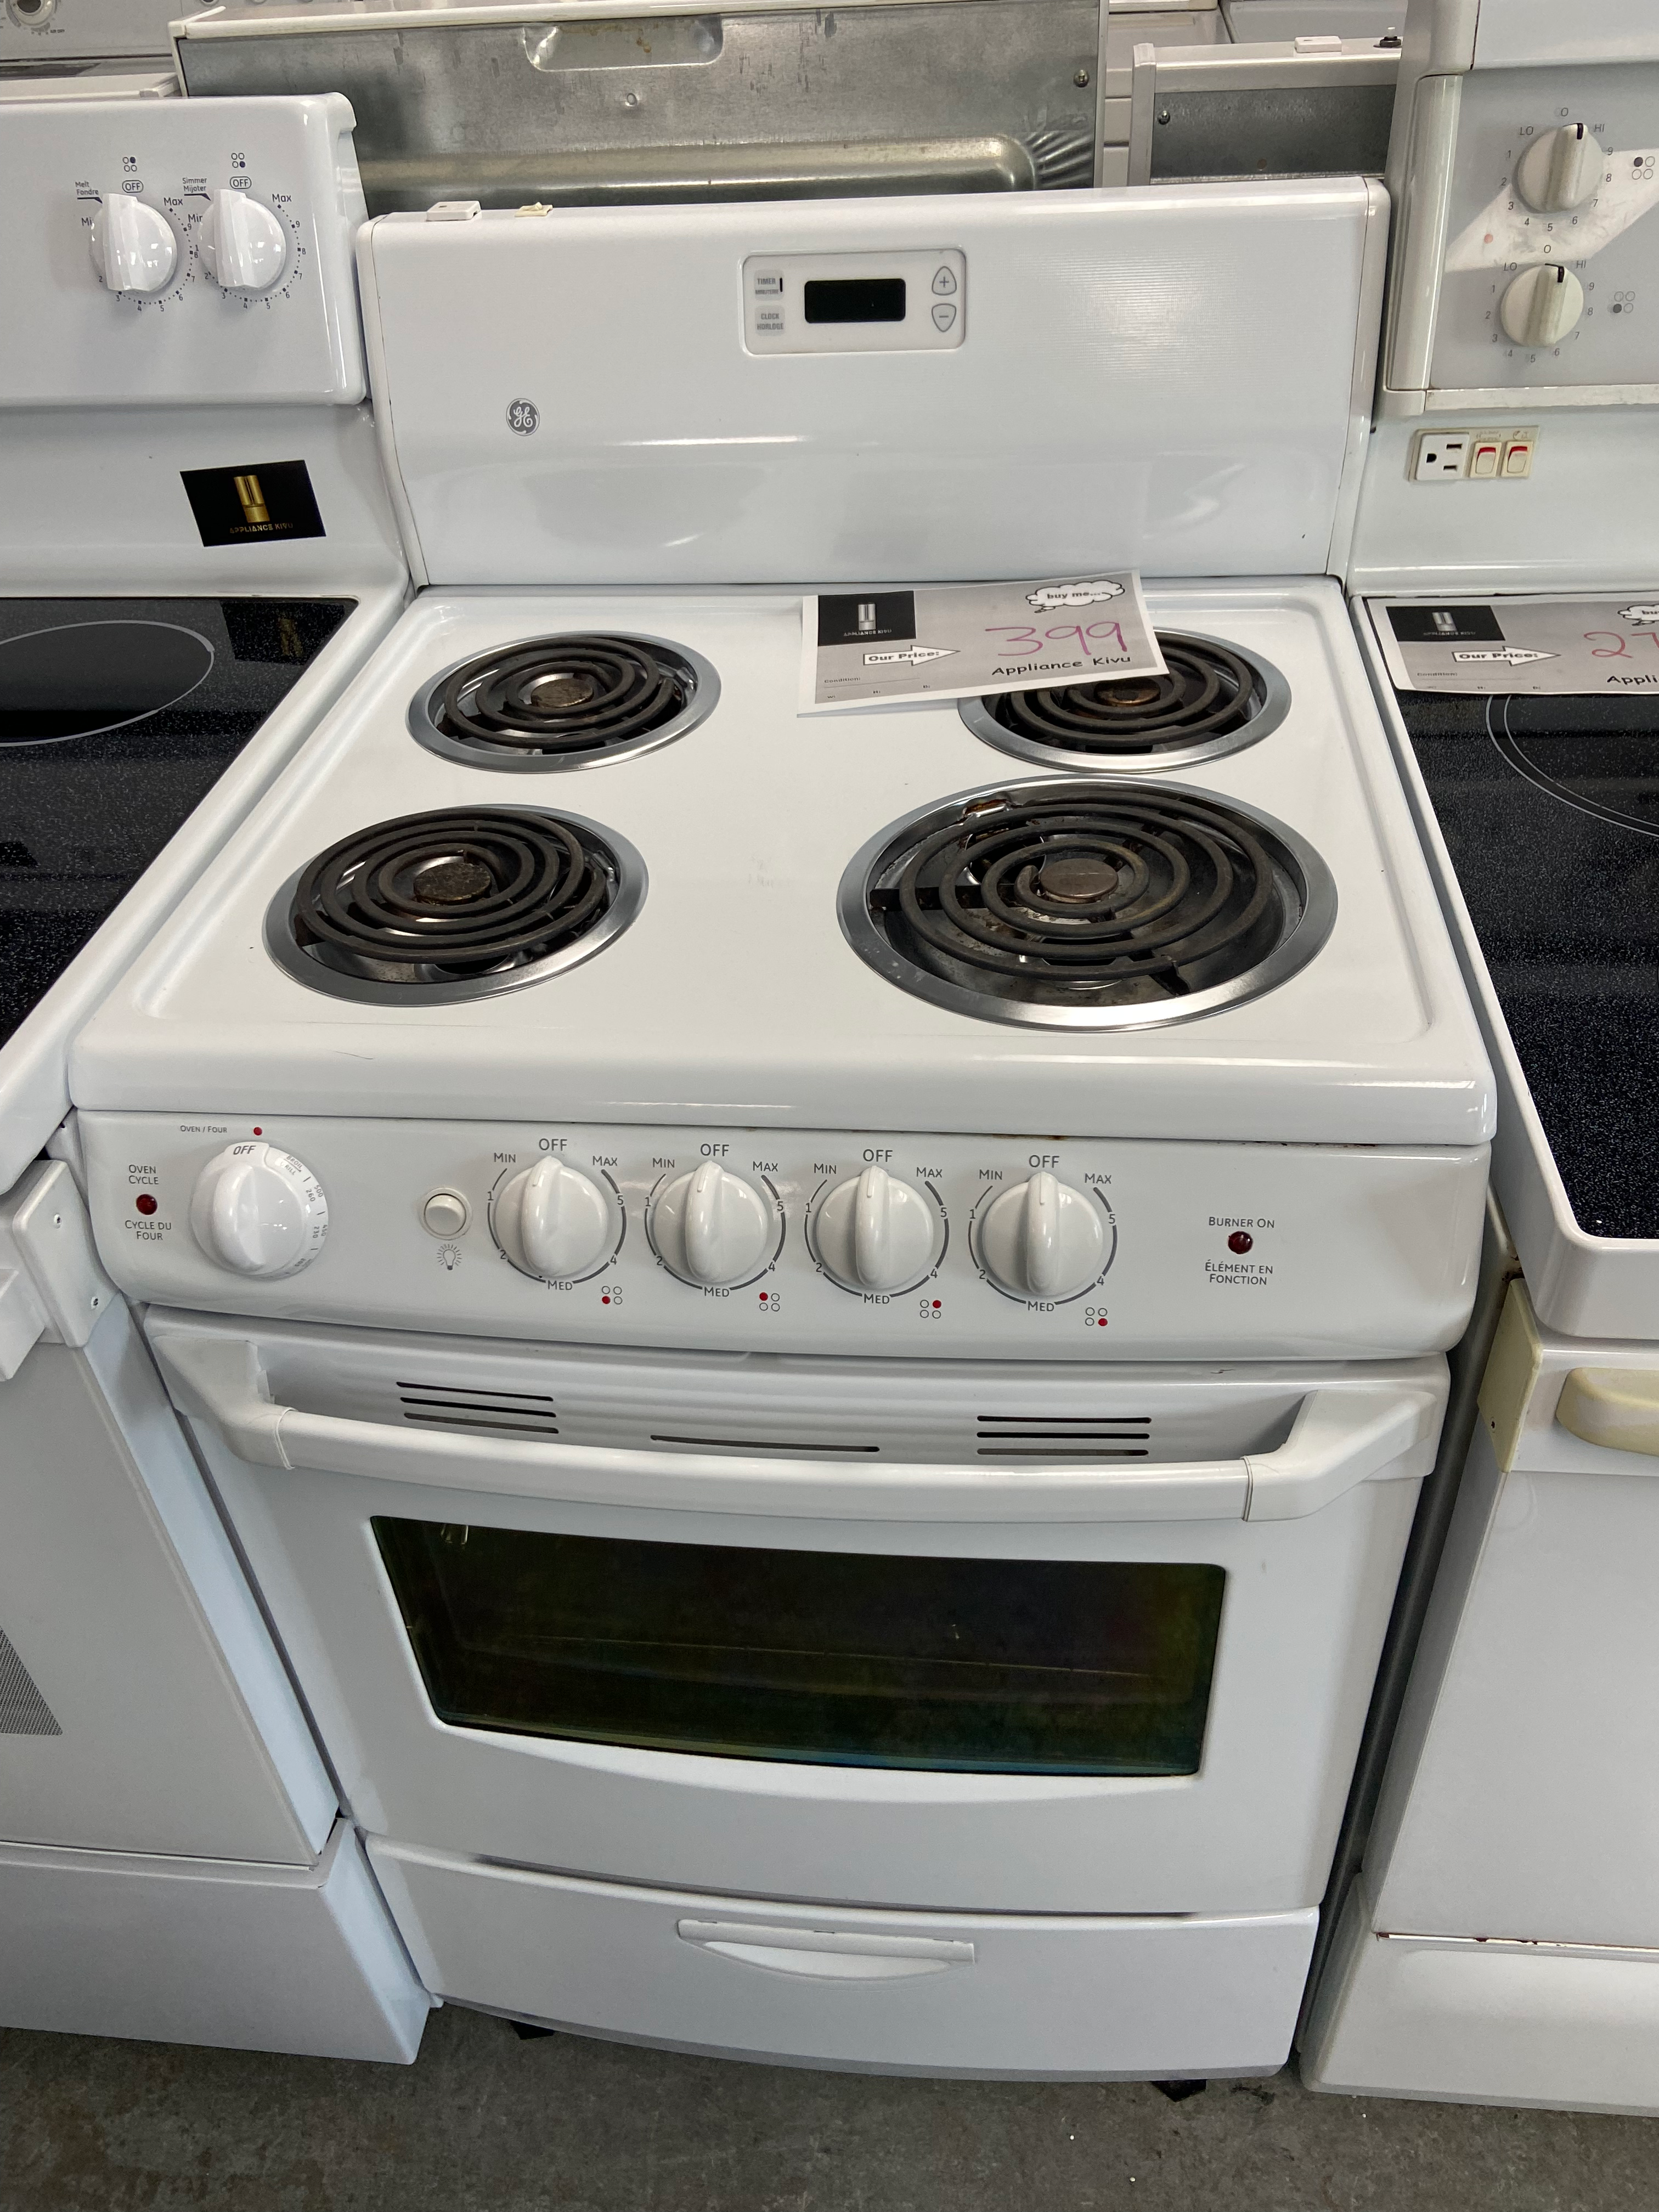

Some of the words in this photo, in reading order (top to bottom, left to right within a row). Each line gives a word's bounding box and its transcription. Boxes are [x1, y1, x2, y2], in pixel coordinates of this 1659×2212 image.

[1520, 127, 1533, 136] LO
[1595, 124, 1605, 132] HI
[1607, 146, 1613, 156] 9
[1501, 178, 1507, 186] 2
[1606, 174, 1611, 182] 8
[125, 183, 141, 191] OFF
[233, 179, 249, 187] OFF
[164, 198, 183, 206] Max
[272, 194, 292, 203] Max
[1508, 202, 1514, 210] 3
[1593, 199, 1599, 208] 7
[81, 217, 92, 226] Mi
[1525, 218, 1530, 226] 4
[1572, 217, 1578, 225] 6
[1548, 223, 1553, 232] 5
[1503, 262, 1517, 272] LO
[1576, 260, 1586, 269] HI
[1492, 285, 1496, 293] 1
[1589, 282, 1595, 291] 9
[1486, 311, 1491, 319] 2
[1587, 307, 1593, 316] 8
[1492, 334, 1498, 342] 3
[1575, 332, 1580, 341] 7
[1508, 349, 1513, 358] 4
[1554, 348, 1560, 357] 6
[1531, 354, 1536, 363] 5
[230, 524, 273, 533] APPLIANCE
[985, 621, 1127, 656] 399
[992, 661, 1083, 675] Appliance
[1093, 657, 1131, 665] Kivu
[1607, 675, 1659, 685] Appli
[539, 1138, 567, 1151] OFF
[233, 1146, 256, 1154] OFF
[700, 1144, 729, 1156] OFF
[494, 1153, 516, 1163] MIN
[863, 1149, 893, 1162] OFF
[286, 1155, 302, 1169] BROIL
[593, 1156, 618, 1166] MAX
[653, 1158, 675, 1168] MIN
[1029, 1155, 1059, 1168] OFF
[129, 1165, 156, 1174] OVEN
[753, 1161, 778, 1172] MAX
[814, 1163, 837, 1174] MIN
[916, 1167, 943, 1178] MAX
[979, 1170, 1002, 1180] MIN
[129, 1176, 159, 1184] CYCLE
[1085, 1173, 1112, 1184] MAX
[306, 1189, 315, 1201] 260
[314, 1185, 323, 1197] 500
[488, 1192, 493, 1201] 1
[617, 1195, 624, 1205] 5
[645, 1197, 651, 1206] 1
[777, 1201, 783, 1211] 5
[805, 1203, 811, 1212] 1
[940, 1208, 947, 1217] 5
[970, 1210, 976, 1219] 1
[1109, 1214, 1115, 1224] 5
[1209, 1217, 1253, 1227] BURNER
[1257, 1218, 1274, 1228] ON
[125, 1220, 154, 1229] CYCLE
[137, 1232, 163, 1240] FOUR
[500, 1250, 506, 1259] 2
[610, 1255, 617, 1265] 4
[656, 1256, 663, 1265] 2
[769, 1262, 775, 1271] 4
[816, 1263, 822, 1272] 2
[1205, 1259, 1255, 1273] ÉLÉMENT
[1259, 1266, 1273, 1274] EN
[930, 1269, 938, 1279] 4
[979, 1270, 985, 1279] 2
[1097, 1277, 1104, 1285] 4
[1210, 1274, 1267, 1285] FONCTION
[549, 1280, 572, 1290] MED
[704, 1287, 730, 1297] MED
[864, 1294, 889, 1304] MED
[1028, 1301, 1054, 1312] MED
